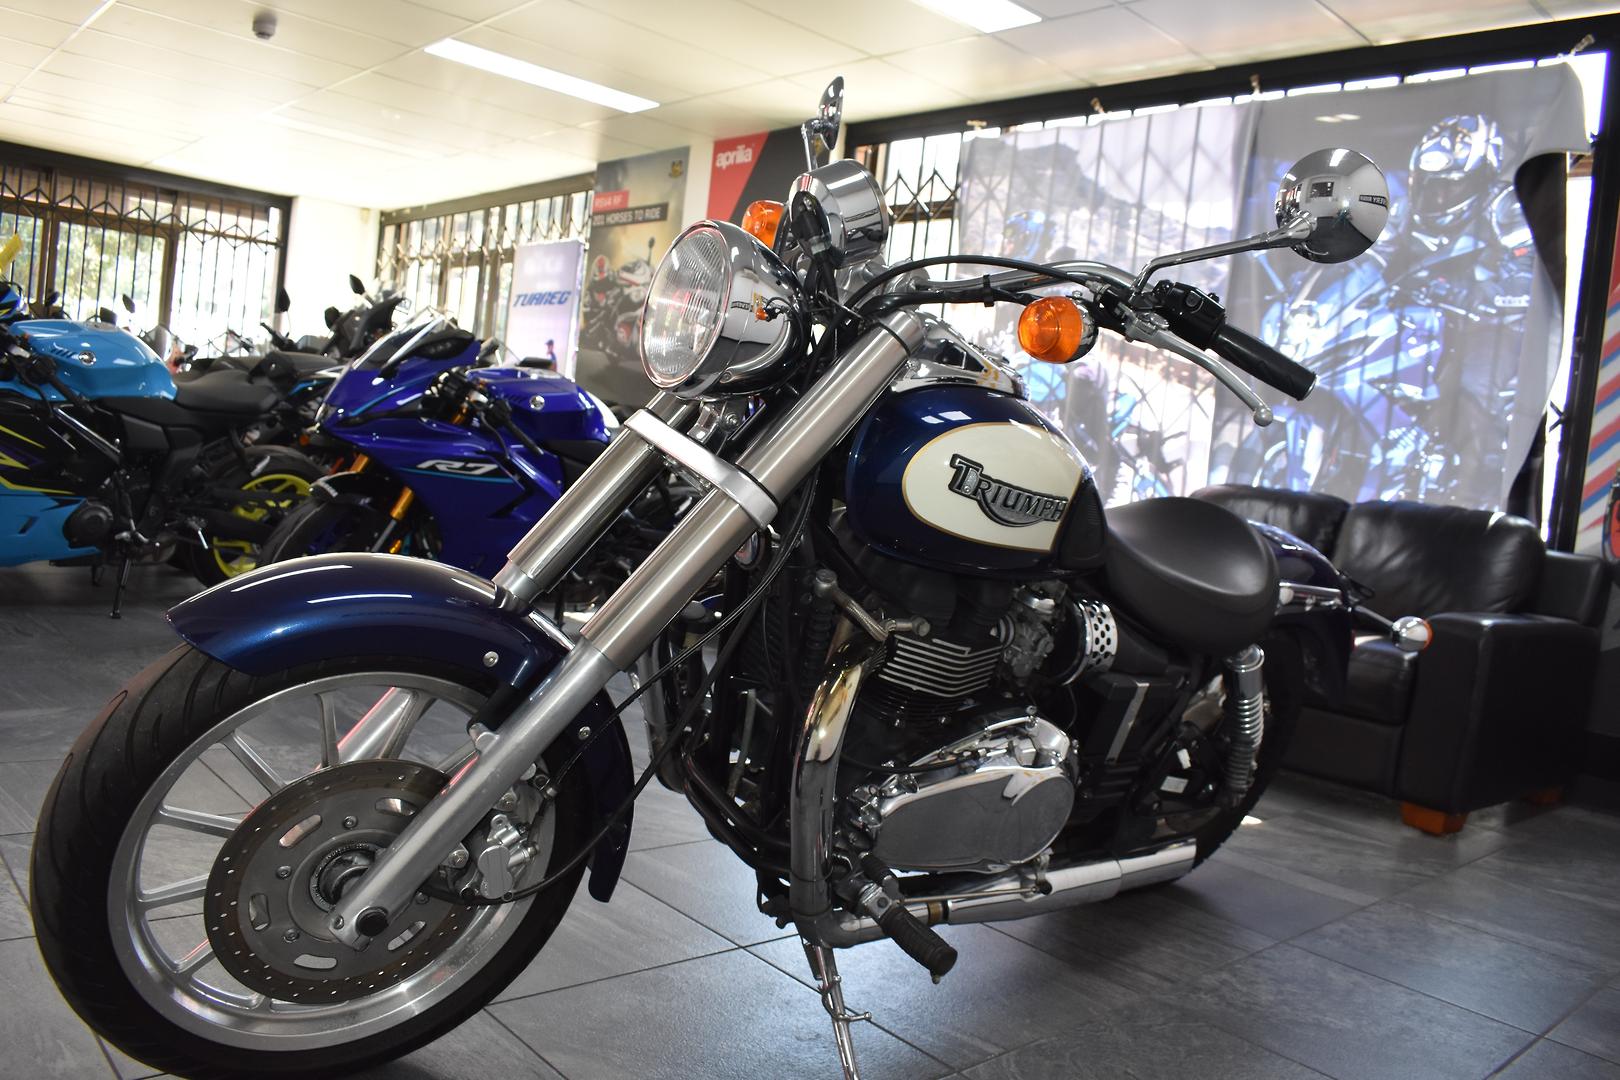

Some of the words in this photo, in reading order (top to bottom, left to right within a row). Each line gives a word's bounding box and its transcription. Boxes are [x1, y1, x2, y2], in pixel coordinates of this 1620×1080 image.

[716, 144, 752, 170] aprilia
[416, 459, 498, 476] R7
[949, 455, 1068, 526] TRIUMPH
